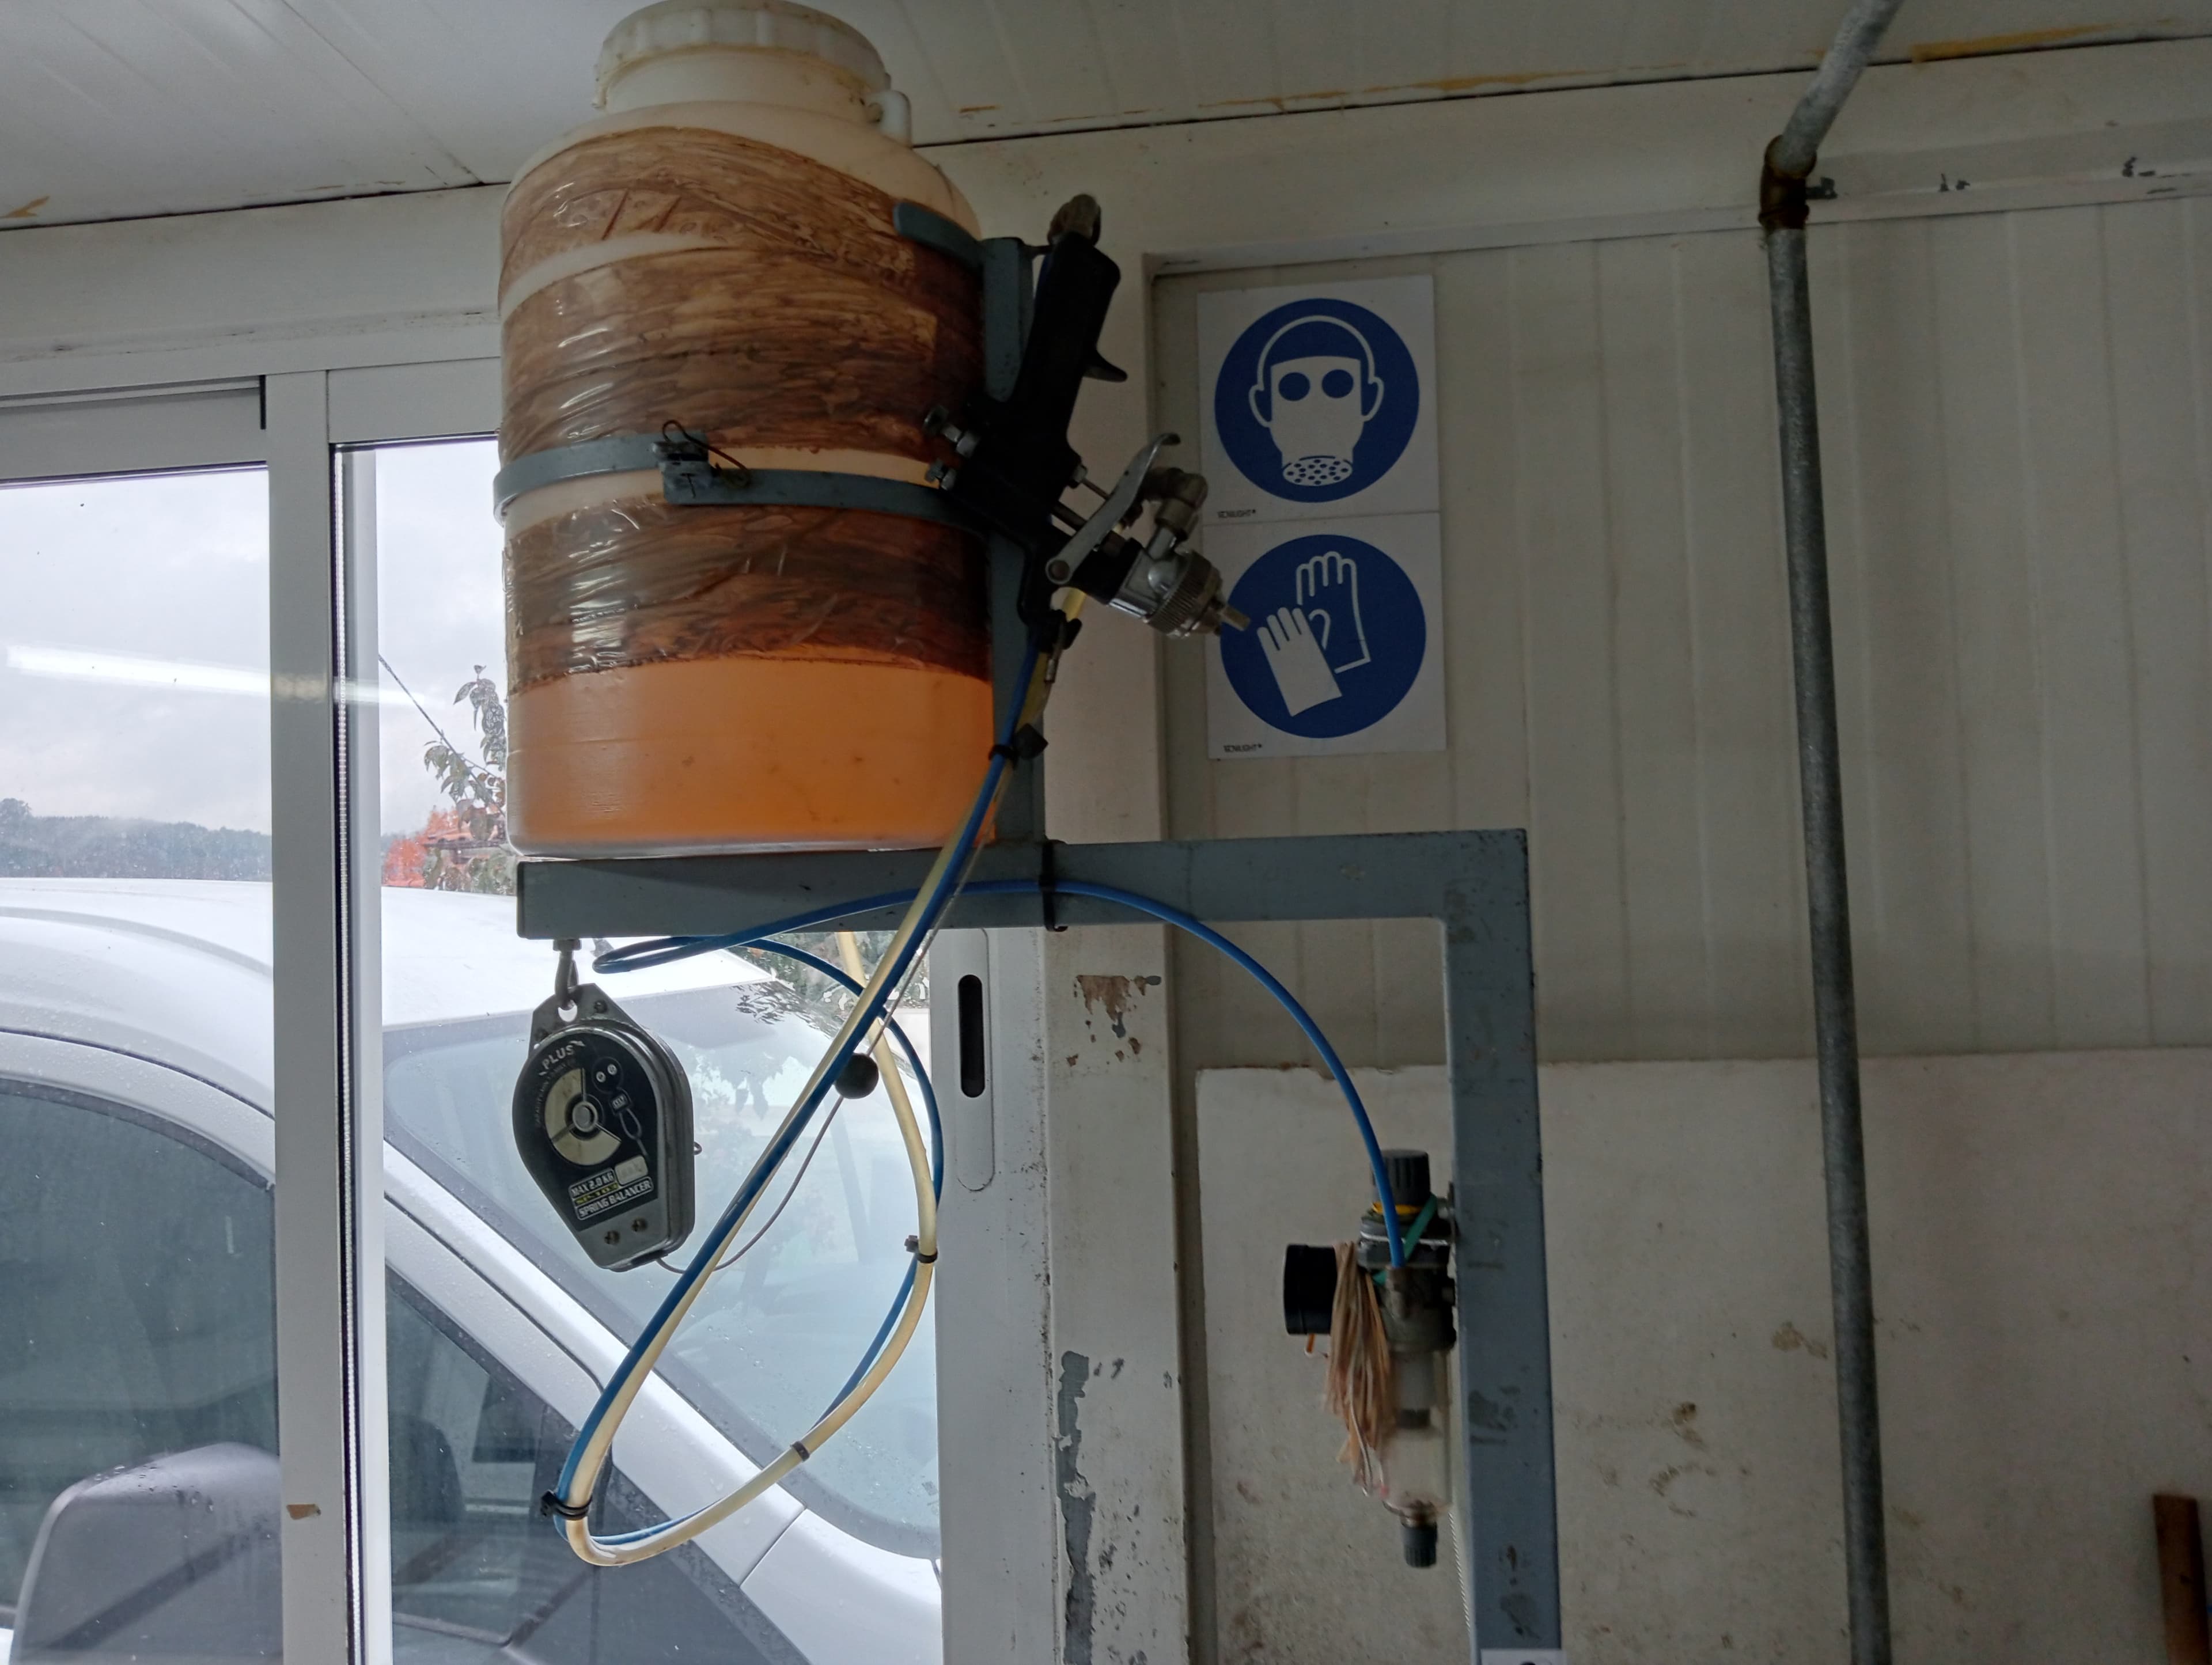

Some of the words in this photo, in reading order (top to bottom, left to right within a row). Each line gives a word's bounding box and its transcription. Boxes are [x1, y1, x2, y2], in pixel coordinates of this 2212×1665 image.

[542, 1045, 574, 1069] PLUS
[571, 1185, 590, 1197] MAX
[601, 1171, 615, 1185] KG
[578, 1198, 609, 1218] SPRING
[608, 1179, 652, 1205] BALANCER
